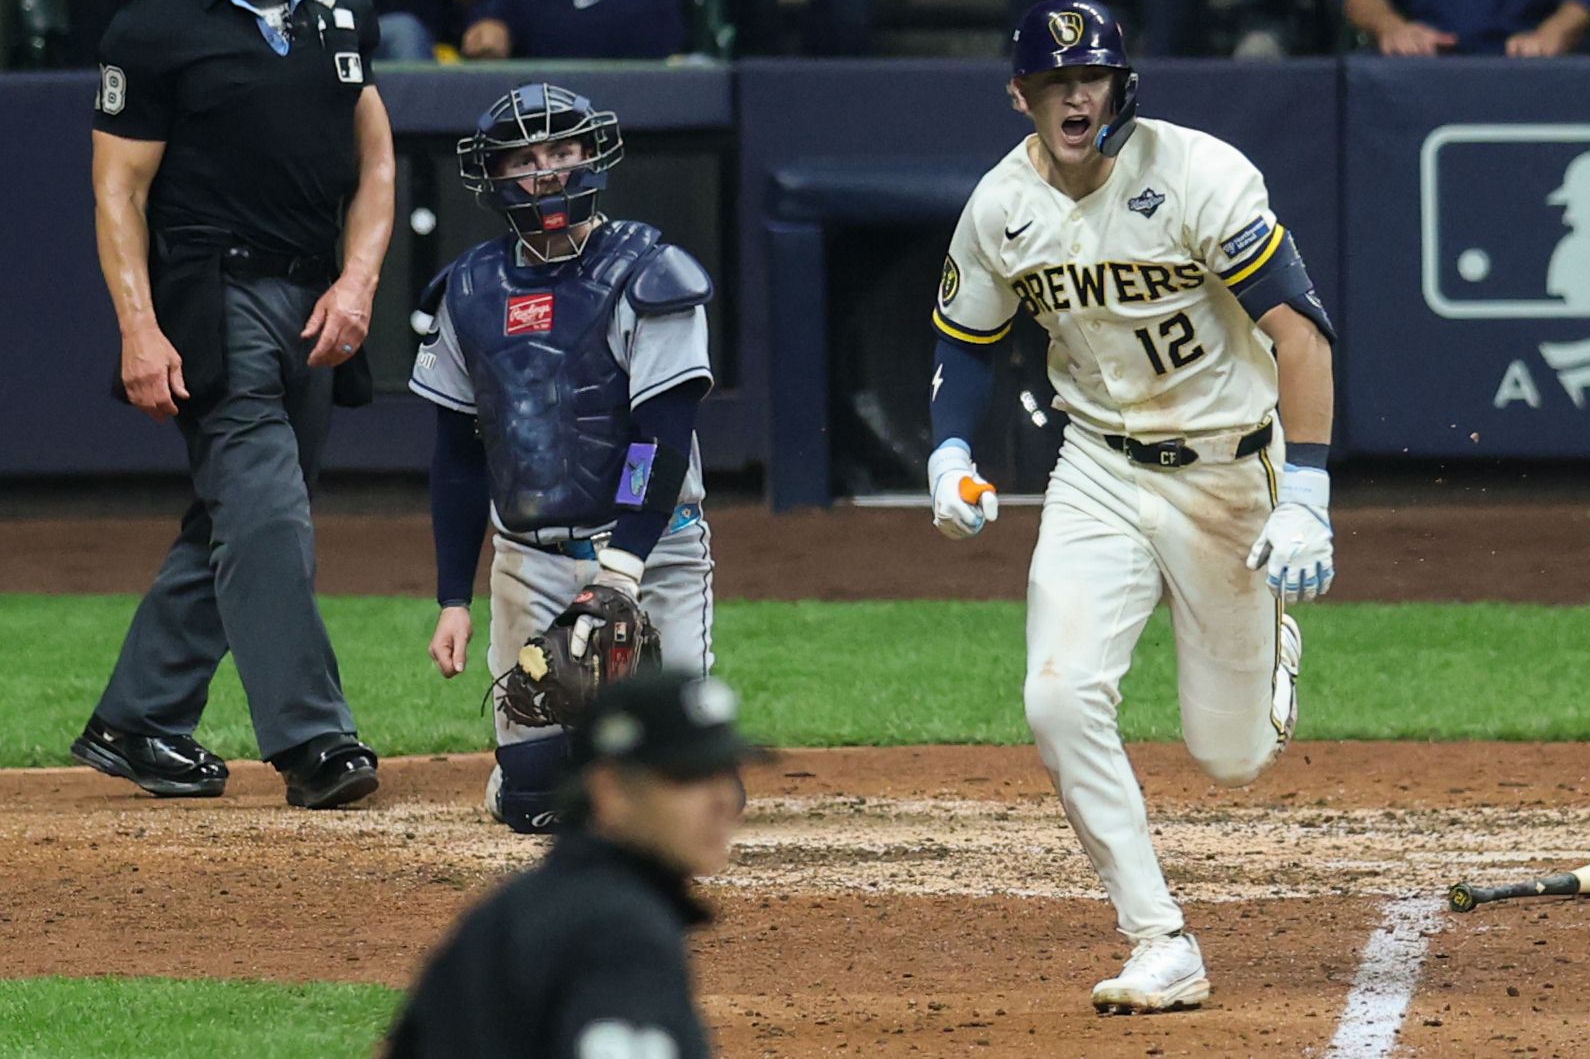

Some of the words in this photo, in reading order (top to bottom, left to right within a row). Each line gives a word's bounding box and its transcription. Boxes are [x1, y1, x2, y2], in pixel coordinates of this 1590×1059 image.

[95, 63, 127, 115] 8
[1012, 260, 1205, 317] BREWERS
[1133, 311, 1205, 376] 12
[1493, 358, 1541, 409] A
